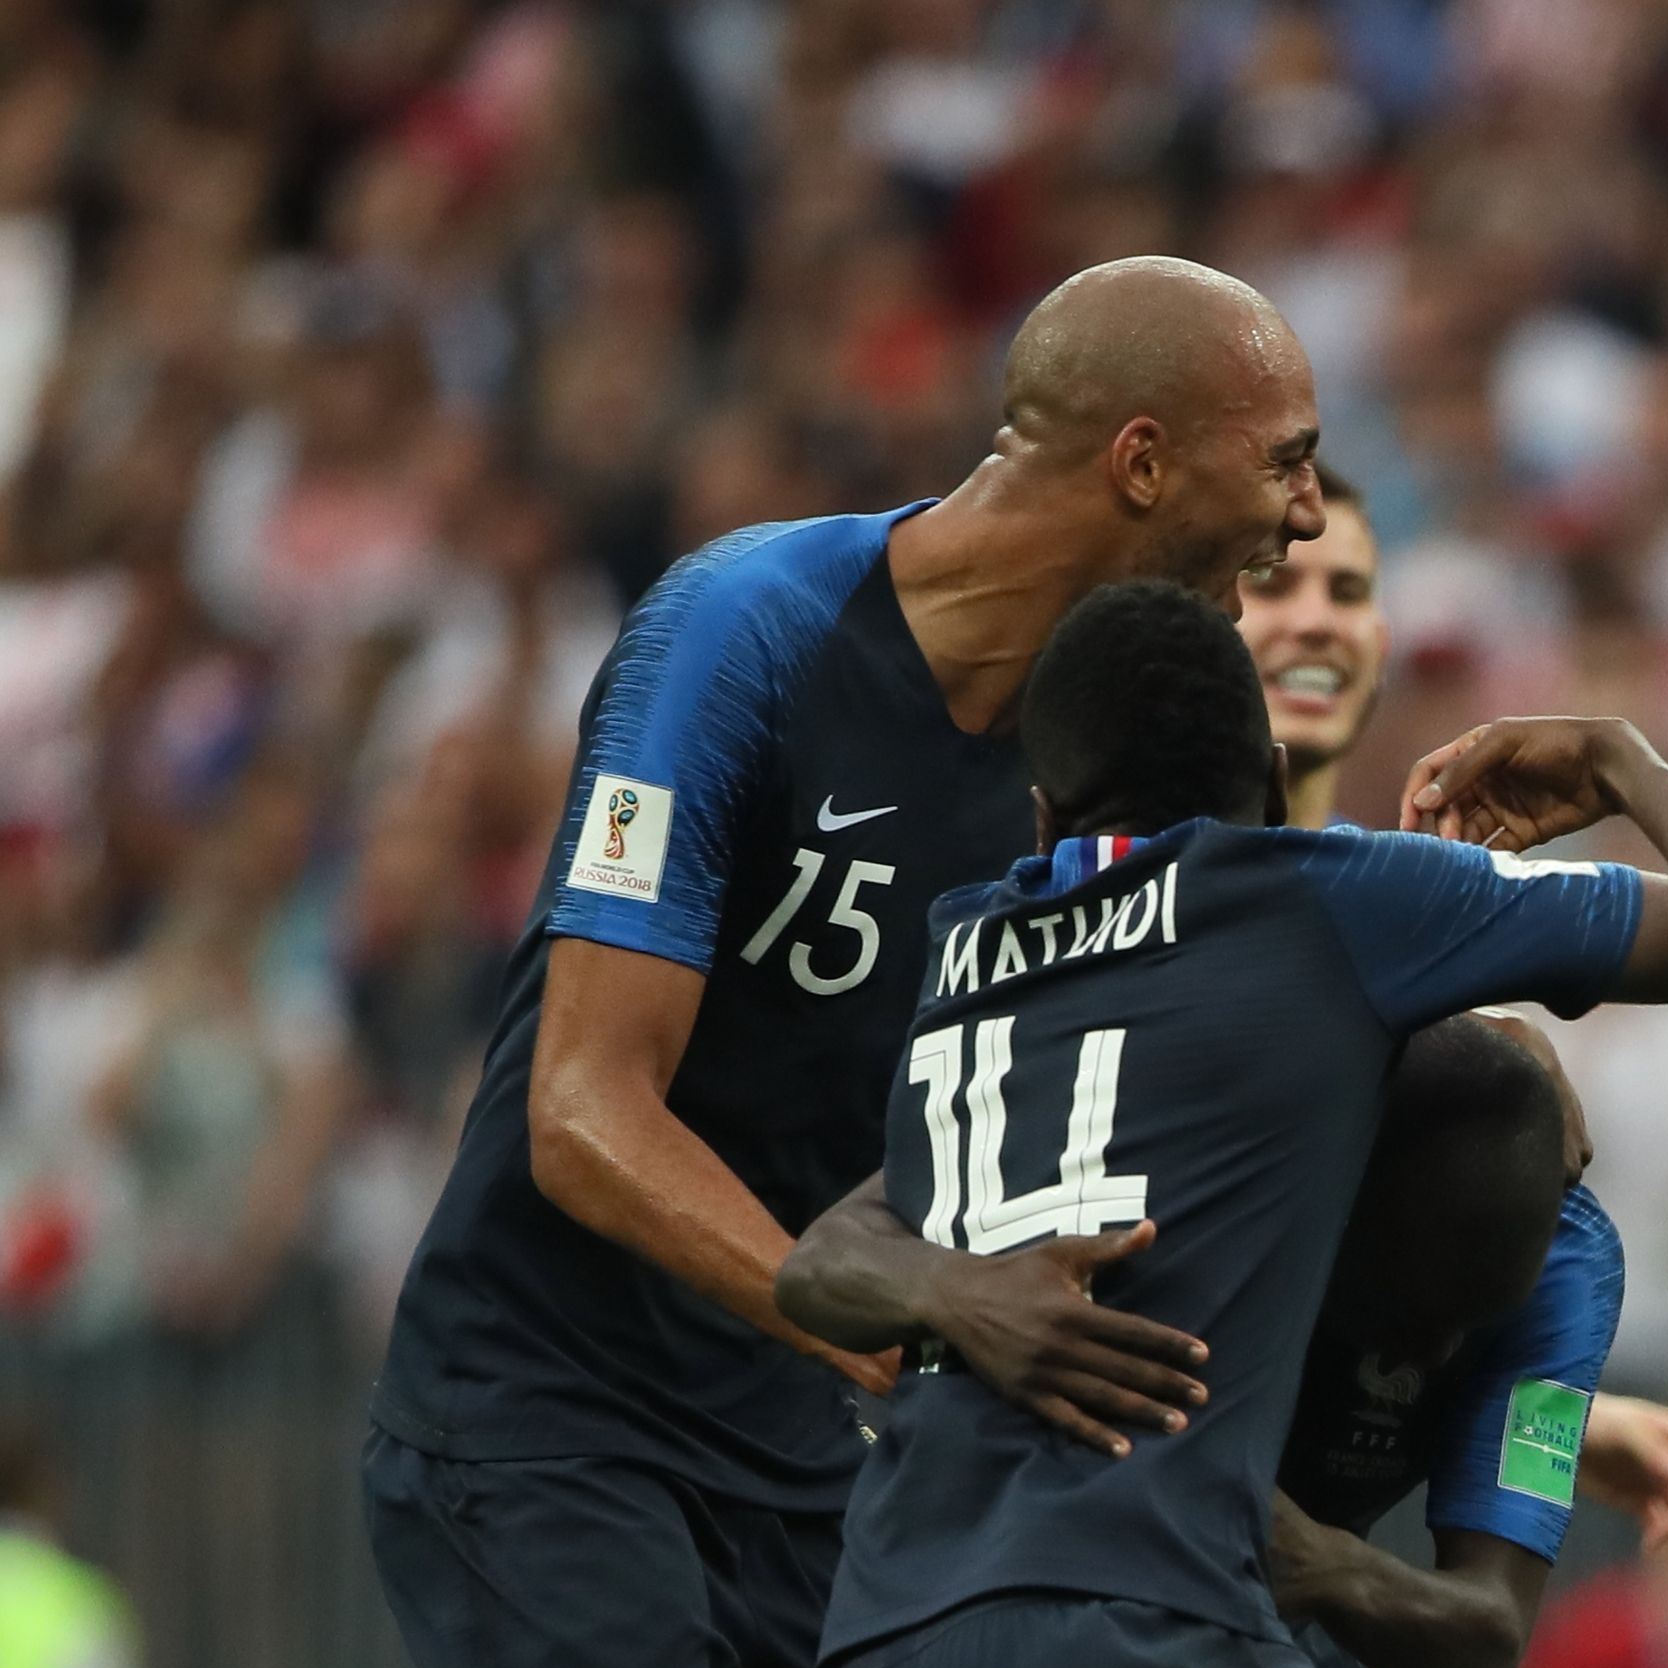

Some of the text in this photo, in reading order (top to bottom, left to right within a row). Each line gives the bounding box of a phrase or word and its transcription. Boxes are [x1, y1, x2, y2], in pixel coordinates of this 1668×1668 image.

[574, 867, 652, 892] RUSSIA 2018
[740, 848, 896, 995] 15
[908, 1015, 1149, 1256] 14
[1516, 1410, 1578, 1438] LIVING
